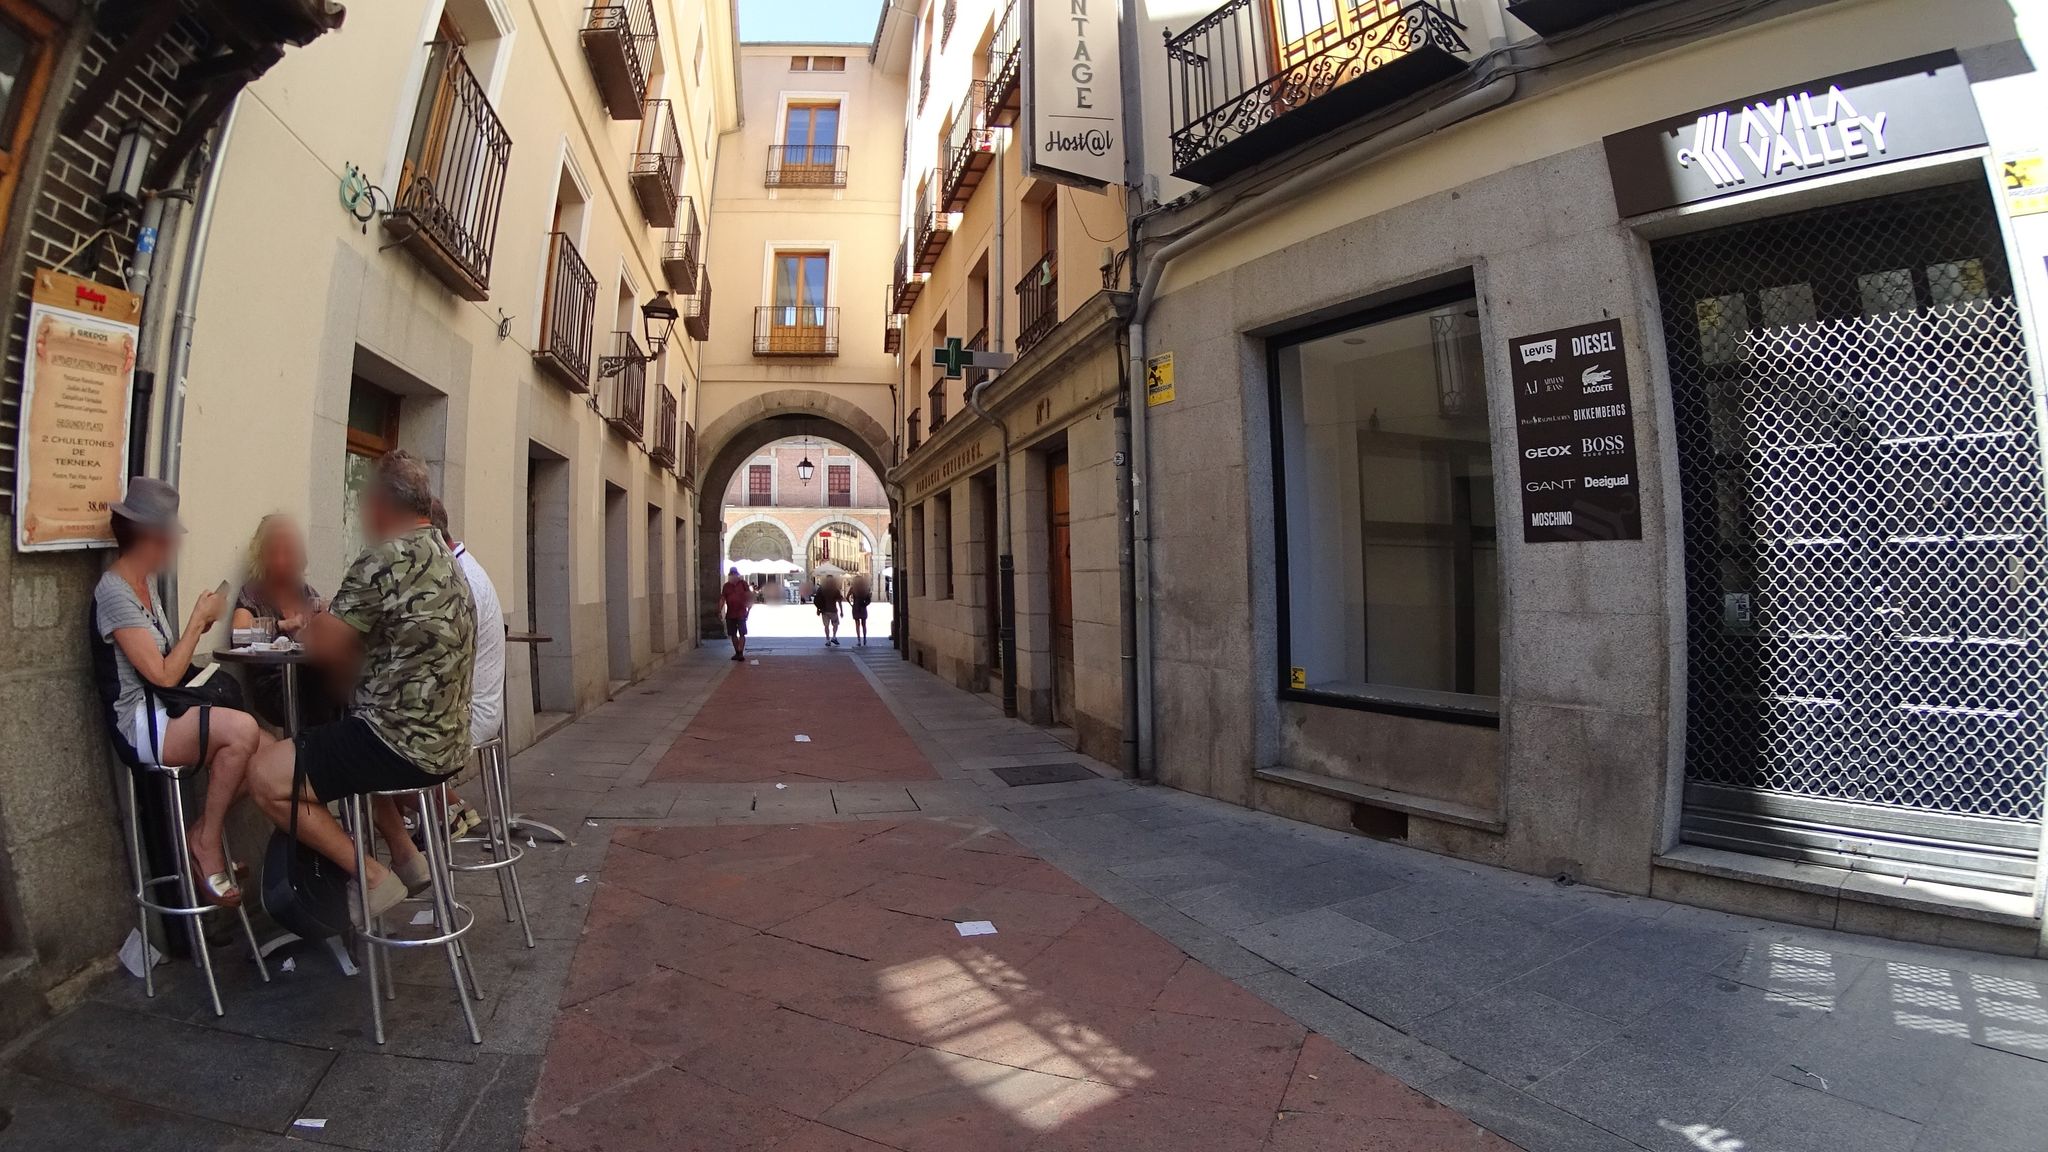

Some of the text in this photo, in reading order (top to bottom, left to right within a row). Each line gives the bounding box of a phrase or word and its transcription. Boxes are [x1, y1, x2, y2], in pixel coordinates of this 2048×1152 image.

[1739, 85, 1858, 144] AVILA
[1045, 129, 1114, 156] Host@l
[1739, 111, 1886, 176] VALLEY
[1571, 331, 1616, 357] DIESEL
[1525, 380, 1538, 395] AJ
[1582, 383, 1613, 395] LACOSTE
[1573, 403, 1626, 421] BIKKEMBERGS
[42, 434, 114, 448] 2 CHULETONES
[1581, 434, 1625, 453] BOSS
[72, 448, 87, 456] DE
[1525, 445, 1572, 459] GEOX
[55, 458, 101, 468] TERNERA
[1526, 478, 1576, 492] GANT
[1584, 474, 1629, 489] Desigual
[1531, 510, 1573, 527] MOSCHINO
